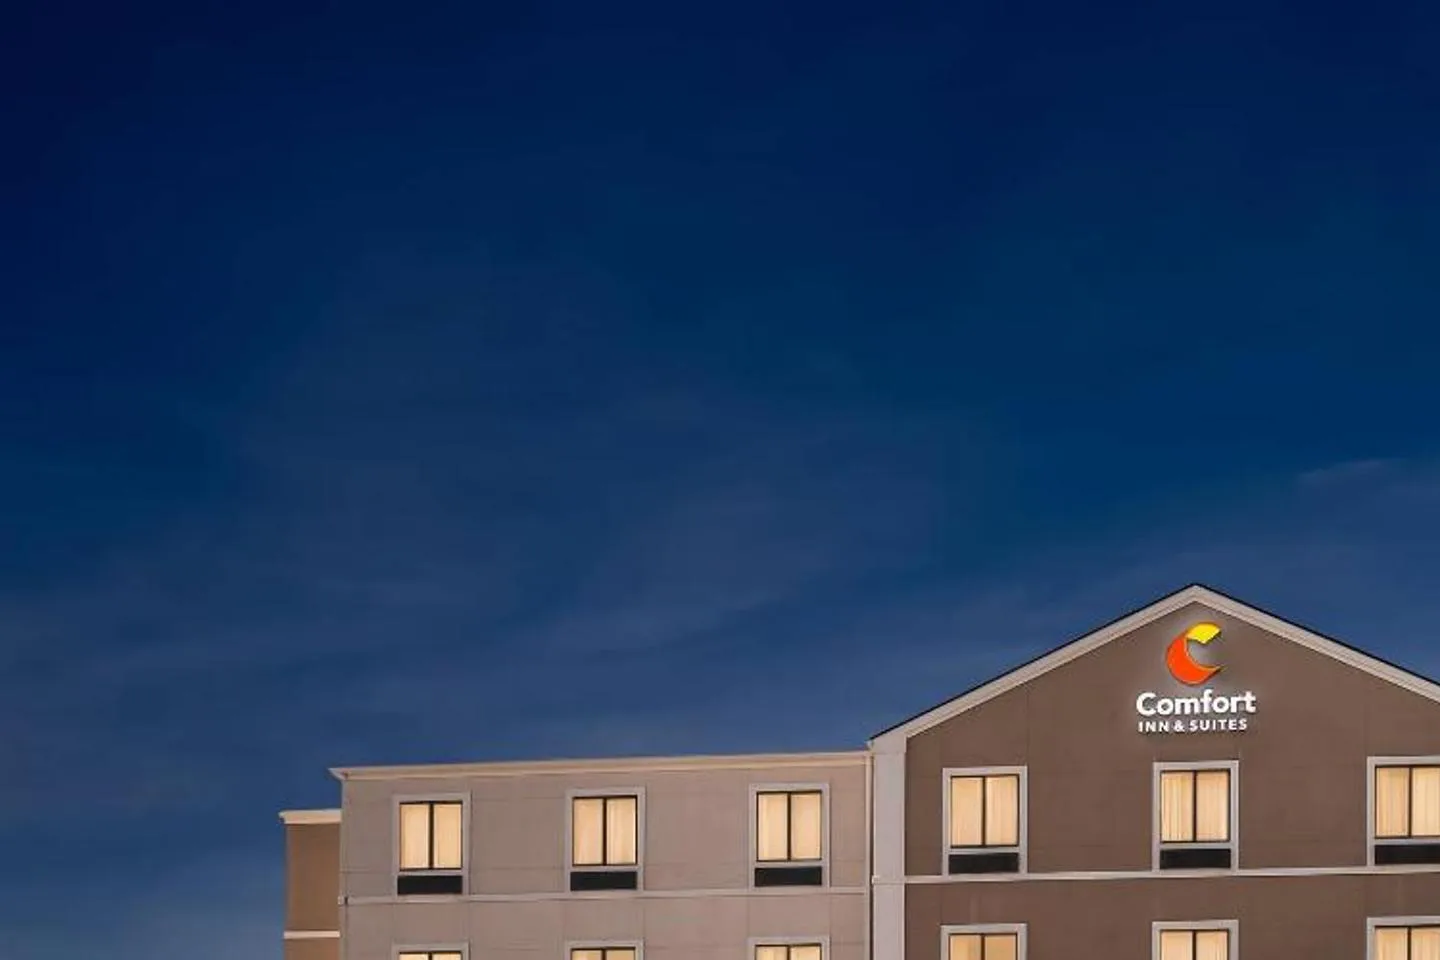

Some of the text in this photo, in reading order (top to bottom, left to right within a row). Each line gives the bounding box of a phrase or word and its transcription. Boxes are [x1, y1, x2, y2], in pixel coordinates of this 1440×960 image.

[1136, 689, 1256, 716] Comfort
[1138, 718, 1248, 732] INN & SUITES
